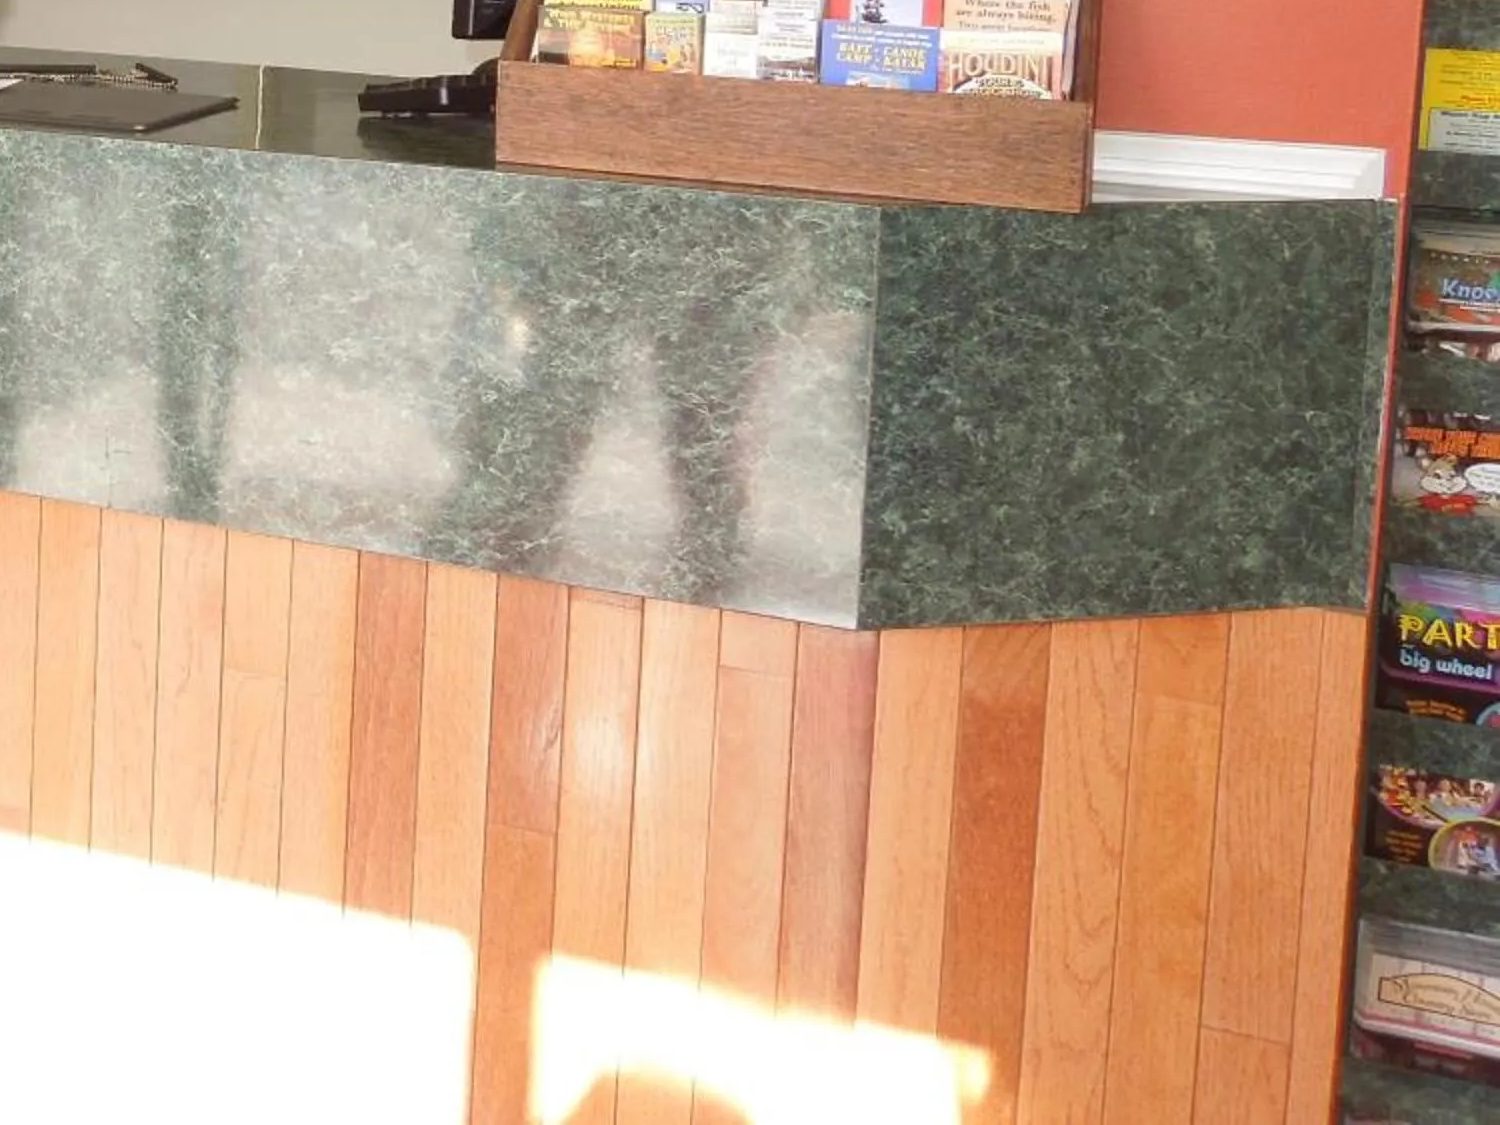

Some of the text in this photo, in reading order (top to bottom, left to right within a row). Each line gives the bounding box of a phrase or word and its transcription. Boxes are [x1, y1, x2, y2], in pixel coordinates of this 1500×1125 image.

[975, 9, 1014, 21] always
[1005, 0, 1024, 10] the
[1028, 0, 1051, 12] fish
[949, 52, 1050, 87] HOUDINI
[1400, 648, 1494, 680] big wheel
